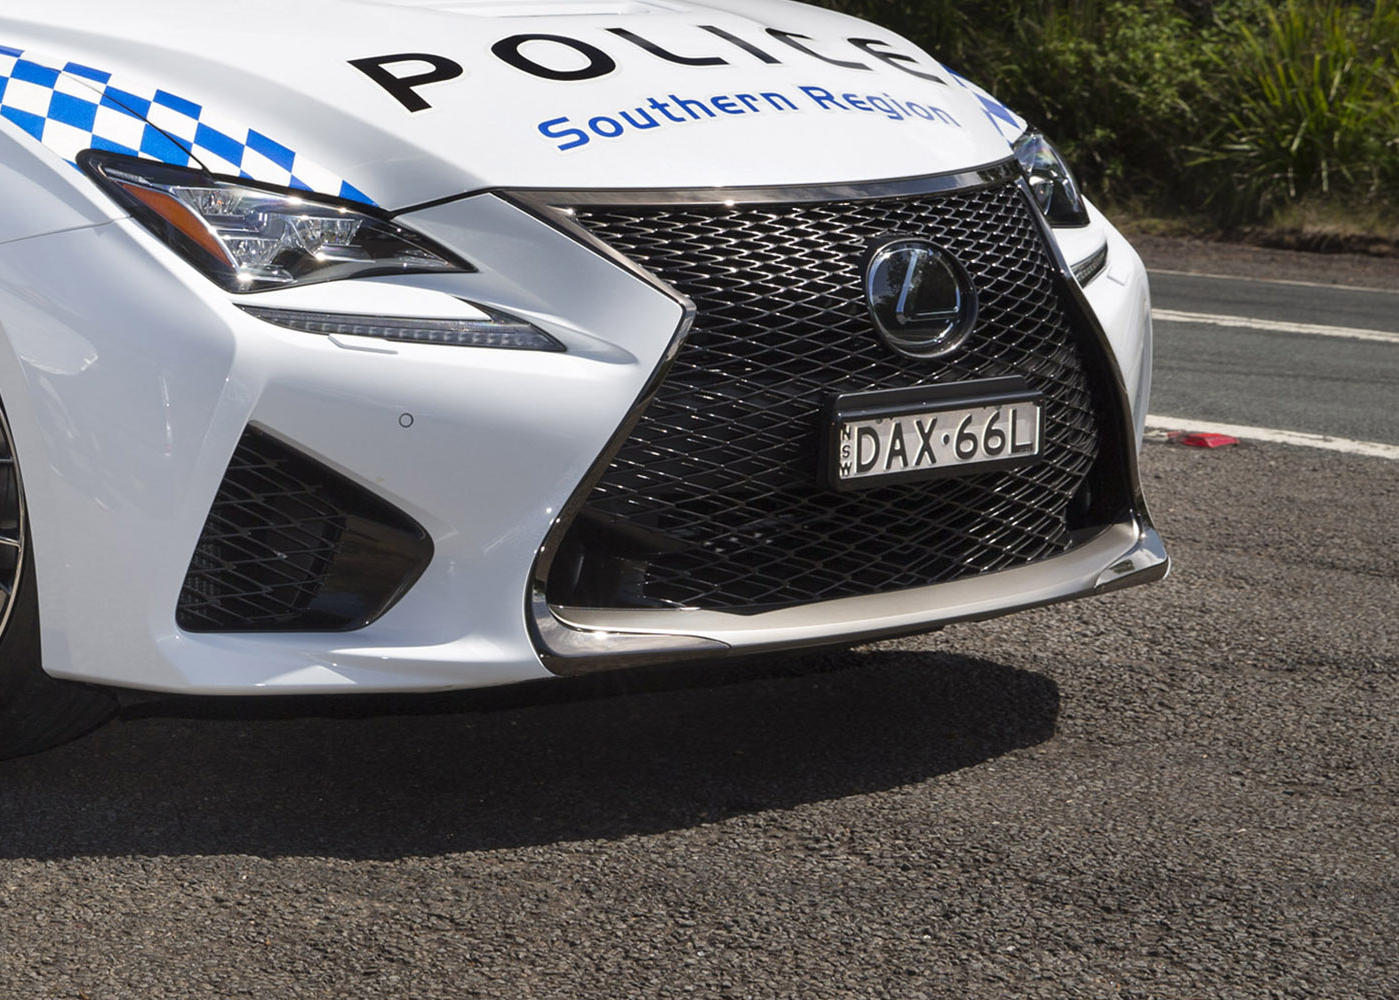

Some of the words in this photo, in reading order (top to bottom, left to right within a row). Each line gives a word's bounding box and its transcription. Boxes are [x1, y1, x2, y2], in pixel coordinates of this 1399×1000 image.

[346, 25, 948, 113] POLICE
[538, 91, 799, 151] Southern
[798, 85, 962, 128] Region
